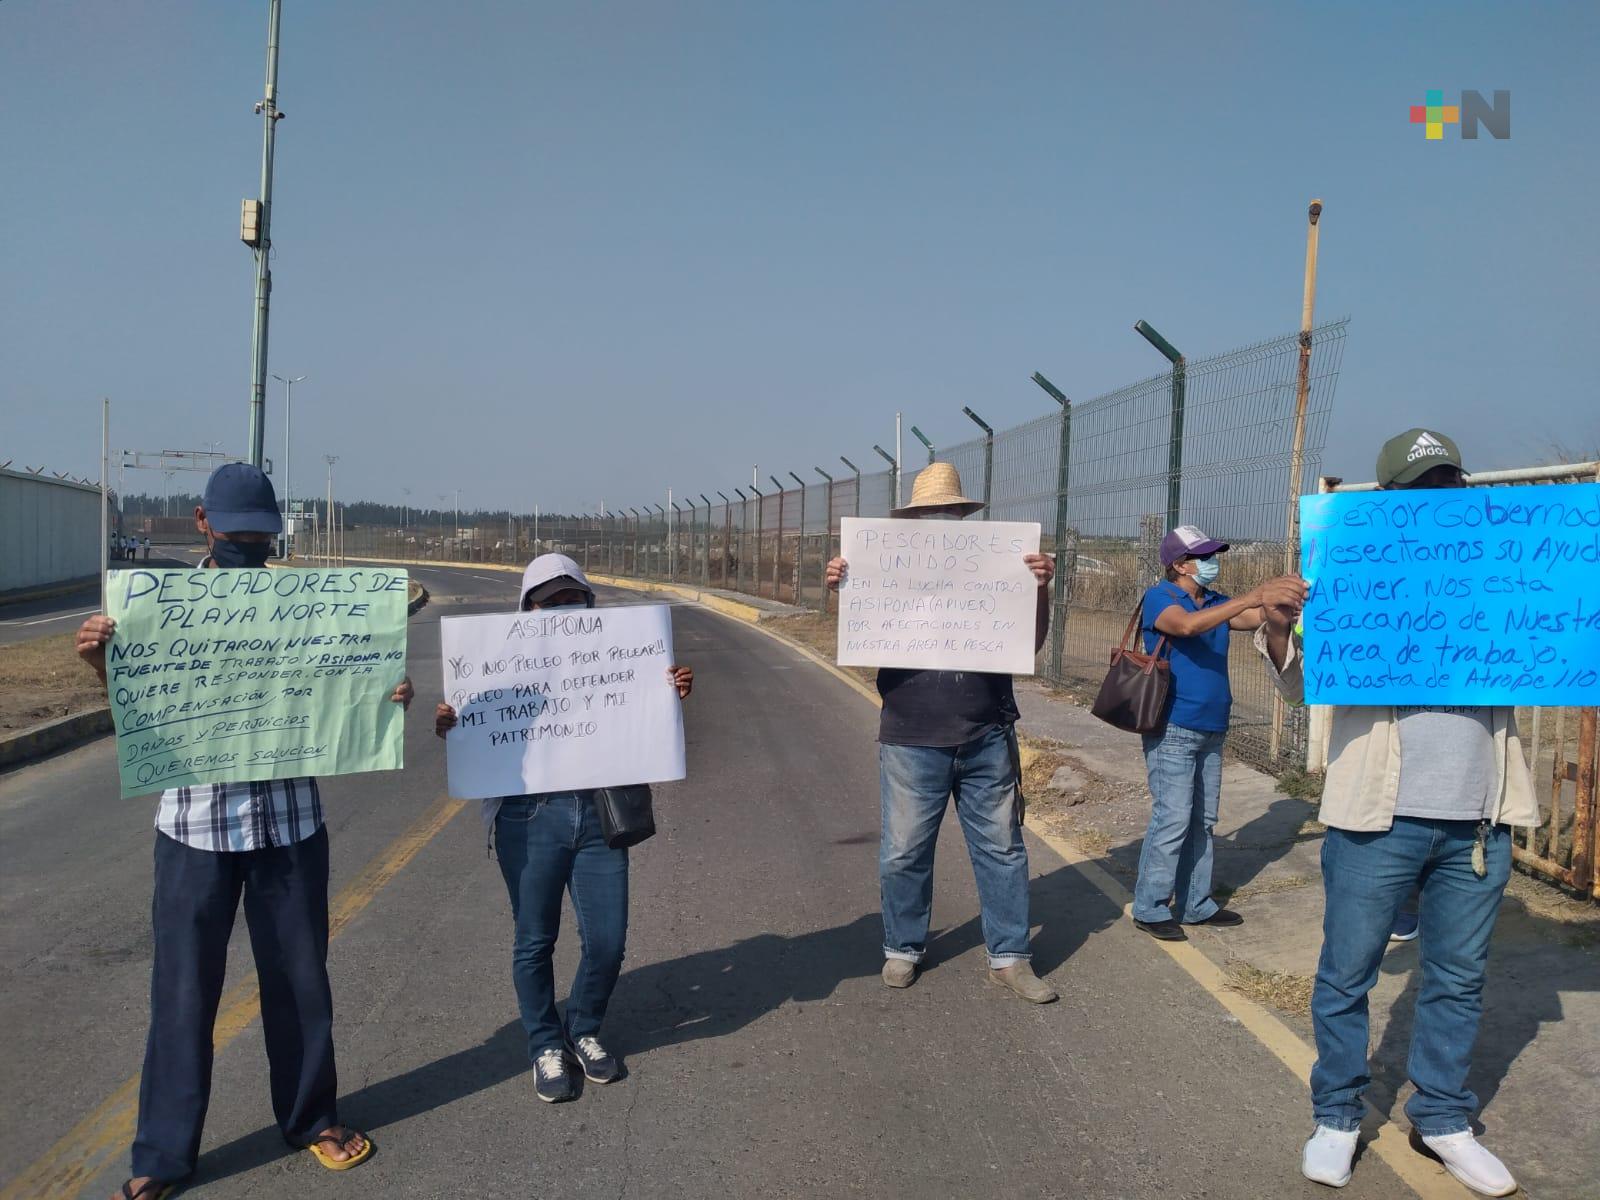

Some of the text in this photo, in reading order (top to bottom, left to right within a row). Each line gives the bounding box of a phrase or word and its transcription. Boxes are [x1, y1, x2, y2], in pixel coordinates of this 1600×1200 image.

[1407, 445, 1449, 462] adidas
[856, 528, 1025, 554] PESCADORES
[879, 554, 981, 572] UNIDOS
[123, 571, 408, 609] PESCADORES DE
[851, 578, 1023, 593] EN LA LUCHA CONTRA
[1483, 568, 1554, 594] esta
[160, 602, 370, 630] PLAYA NORTE
[505, 615, 603, 641] ASIPONA
[847, 619, 1016, 633] POR AFECTACIONES EN
[1458, 602, 1490, 632] de
[110, 641, 157, 664] NOS
[286, 633, 372, 650] NUESTRA
[846, 639, 901, 651] NUESTRA
[943, 639, 958, 650] DE
[963, 639, 1004, 652] PESCA
[1316, 639, 1387, 670] Area
[1396, 634, 1425, 665] de
[113, 661, 188, 682] FUENTE
[220, 655, 299, 669] TRABAJO
[384, 650, 403, 661] NO
[313, 668, 347, 678] CON
[351, 666, 373, 676] LA
[448, 655, 474, 680] YO
[481, 659, 508, 677] NO
[508, 653, 563, 674] PELEO
[568, 649, 601, 666] POR
[1342, 663, 1418, 689] basta
[1425, 662, 1450, 689] de
[281, 687, 313, 698] POR
[450, 669, 636, 709] PELEO PARA DEFENDER
[461, 691, 628, 728] MI TRABAJO Y MI
[488, 720, 599, 747] PATRIMONIO
[136, 752, 240, 785] QUEREMOS
